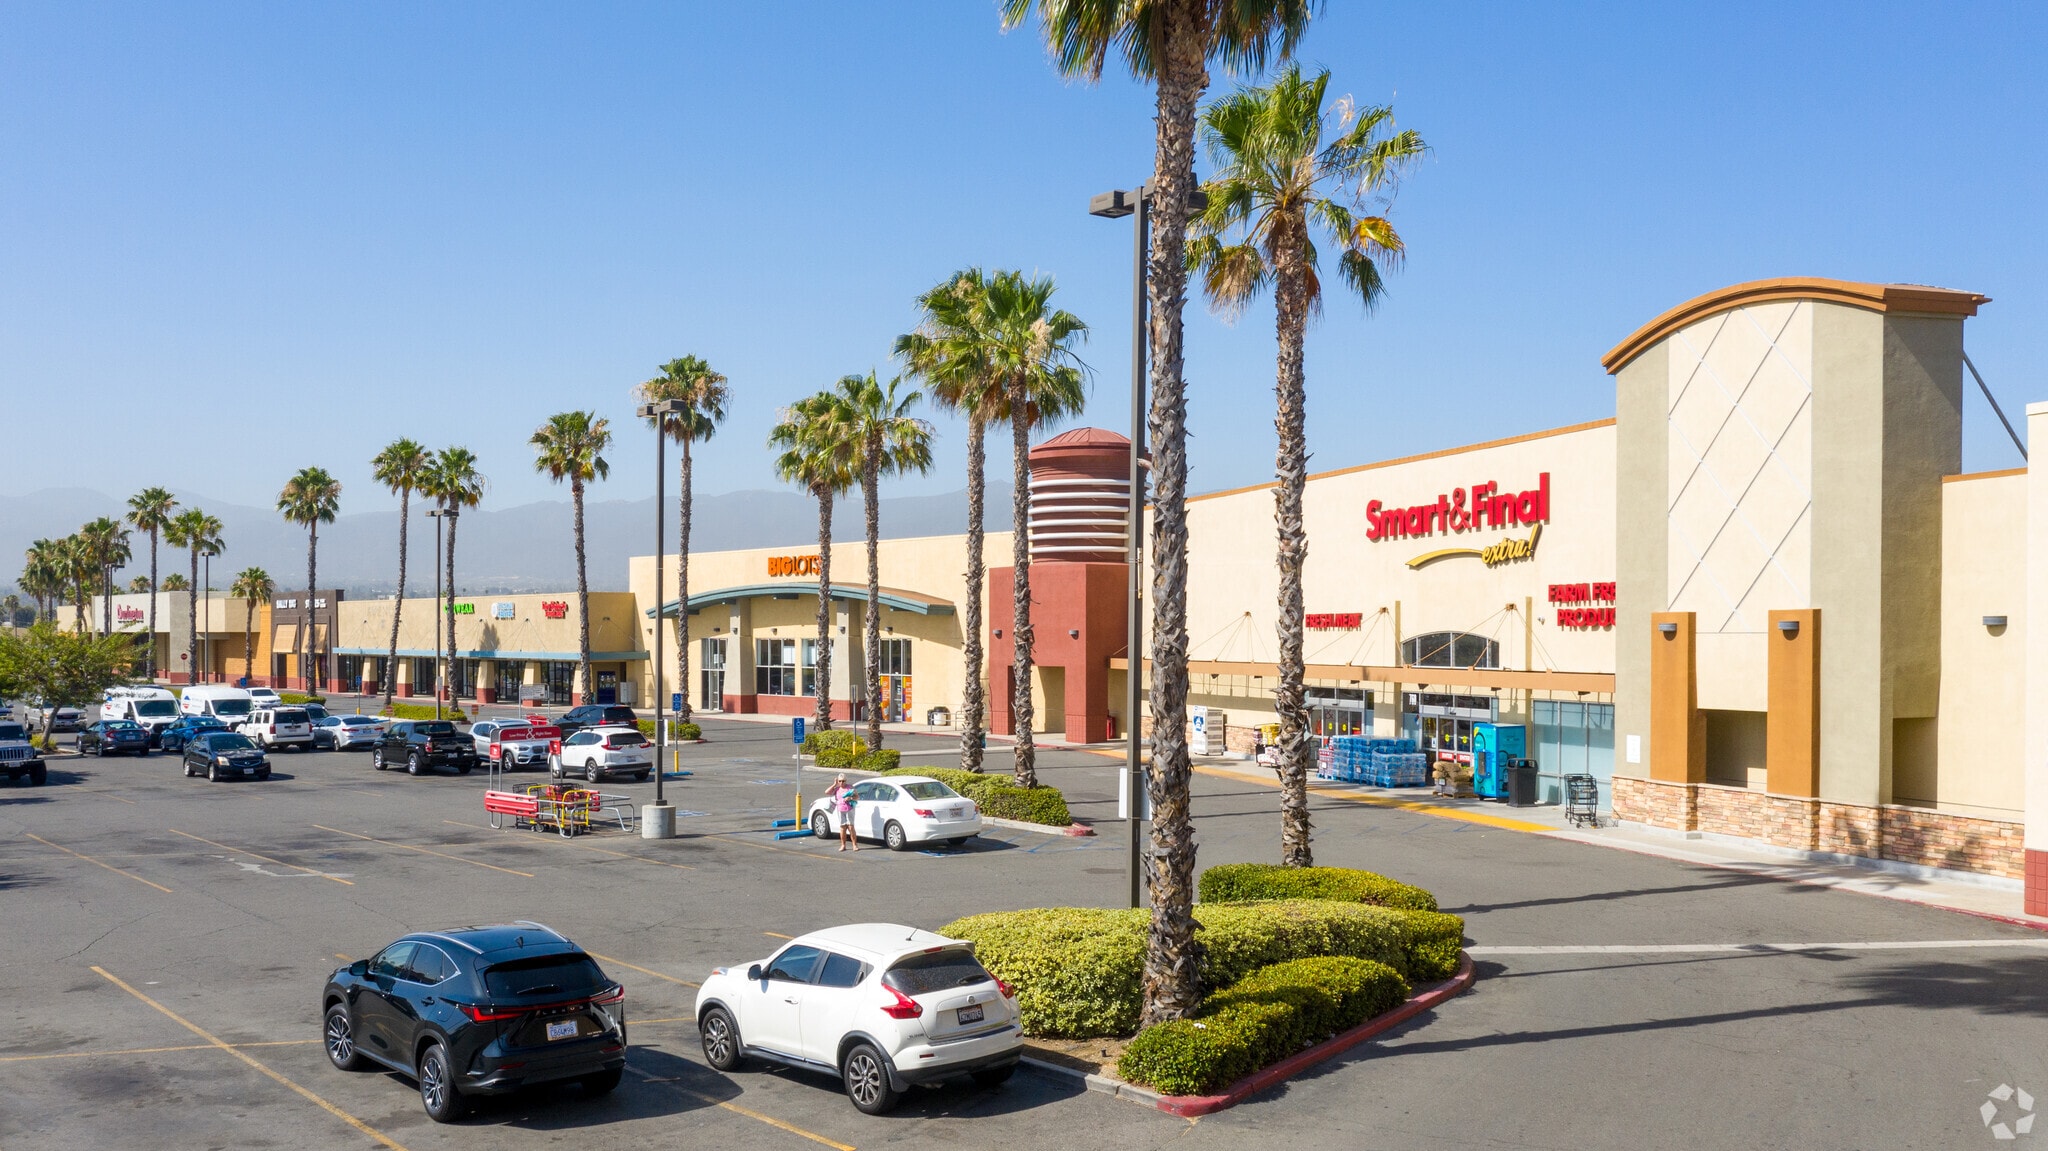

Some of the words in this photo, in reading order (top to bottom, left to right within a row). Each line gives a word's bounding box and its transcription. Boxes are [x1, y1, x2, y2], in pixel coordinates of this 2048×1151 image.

[1481, 523, 1541, 565] extra!
[1548, 583, 1591, 603] FARM
[1305, 613, 1334, 628] FRESH
[1335, 612, 1362, 628] MEAT
